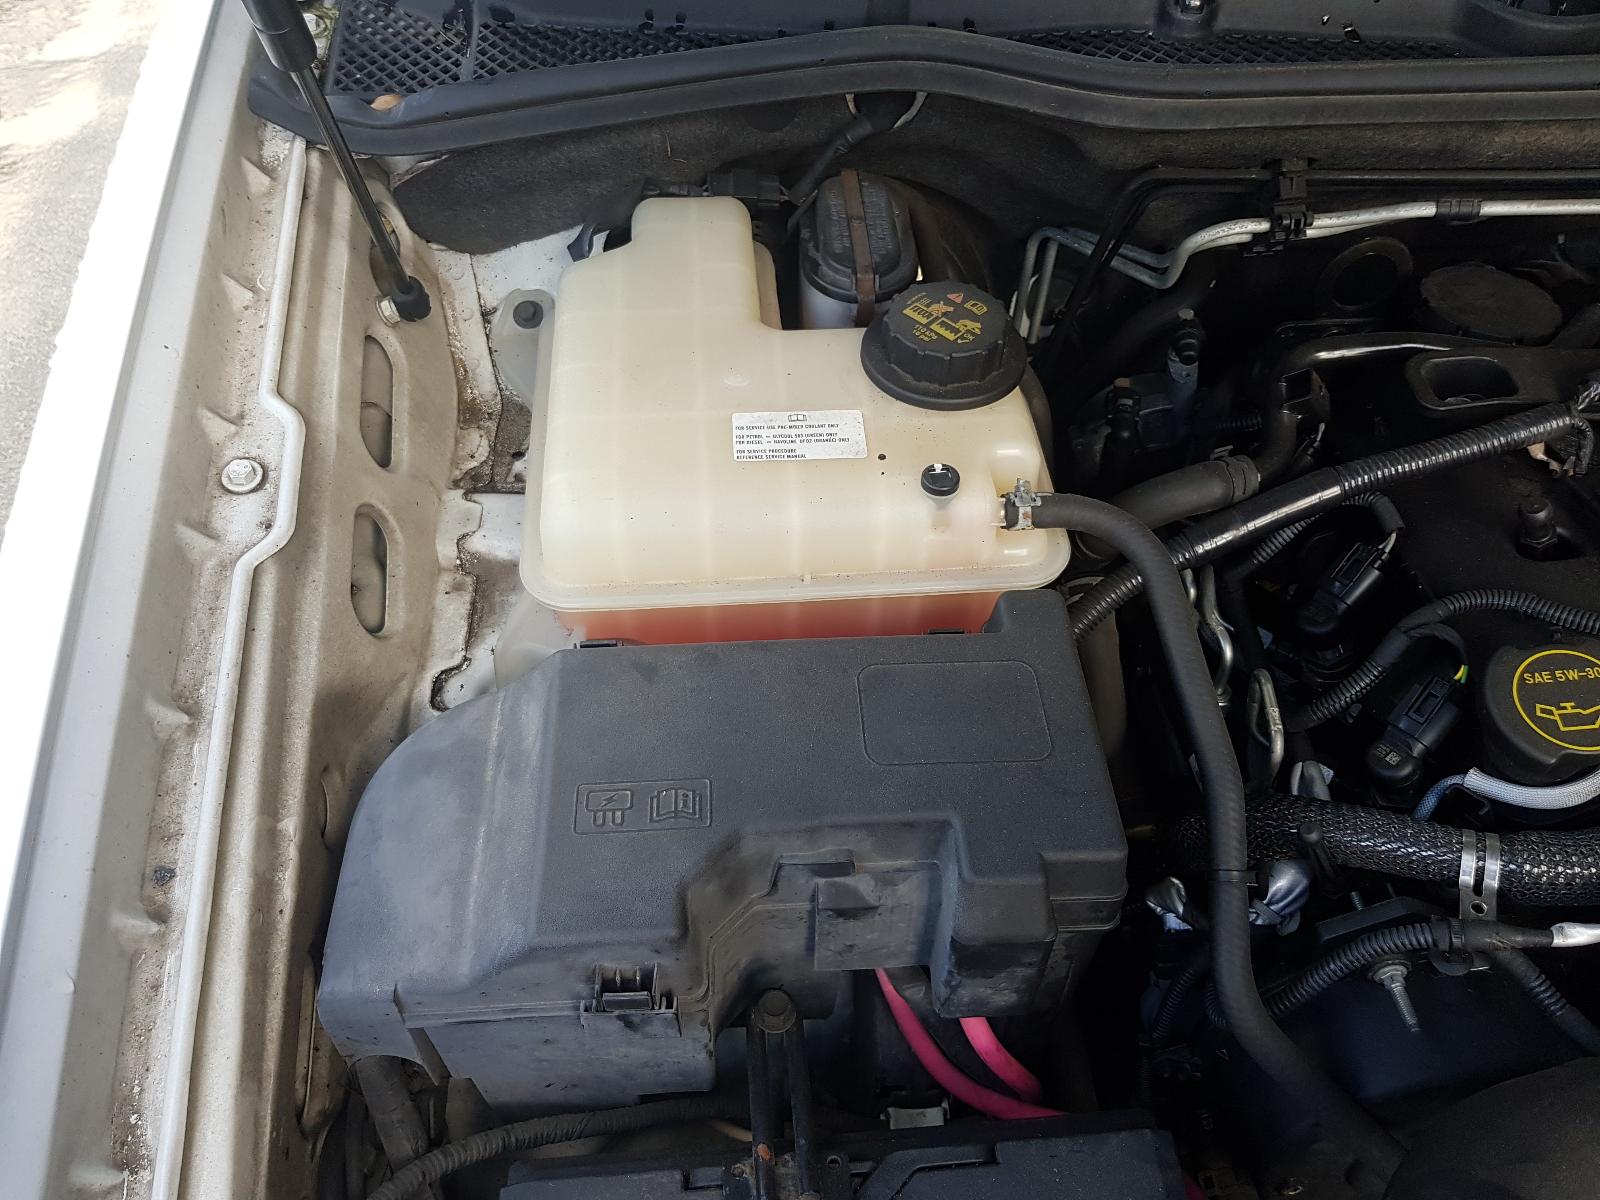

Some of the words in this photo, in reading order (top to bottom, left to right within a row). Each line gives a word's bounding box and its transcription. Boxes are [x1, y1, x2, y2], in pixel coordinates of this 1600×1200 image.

[963, 333, 975, 341] OK
[1523, 671, 1553, 684] SAE
[1554, 667, 1600, 682] 5W-30
